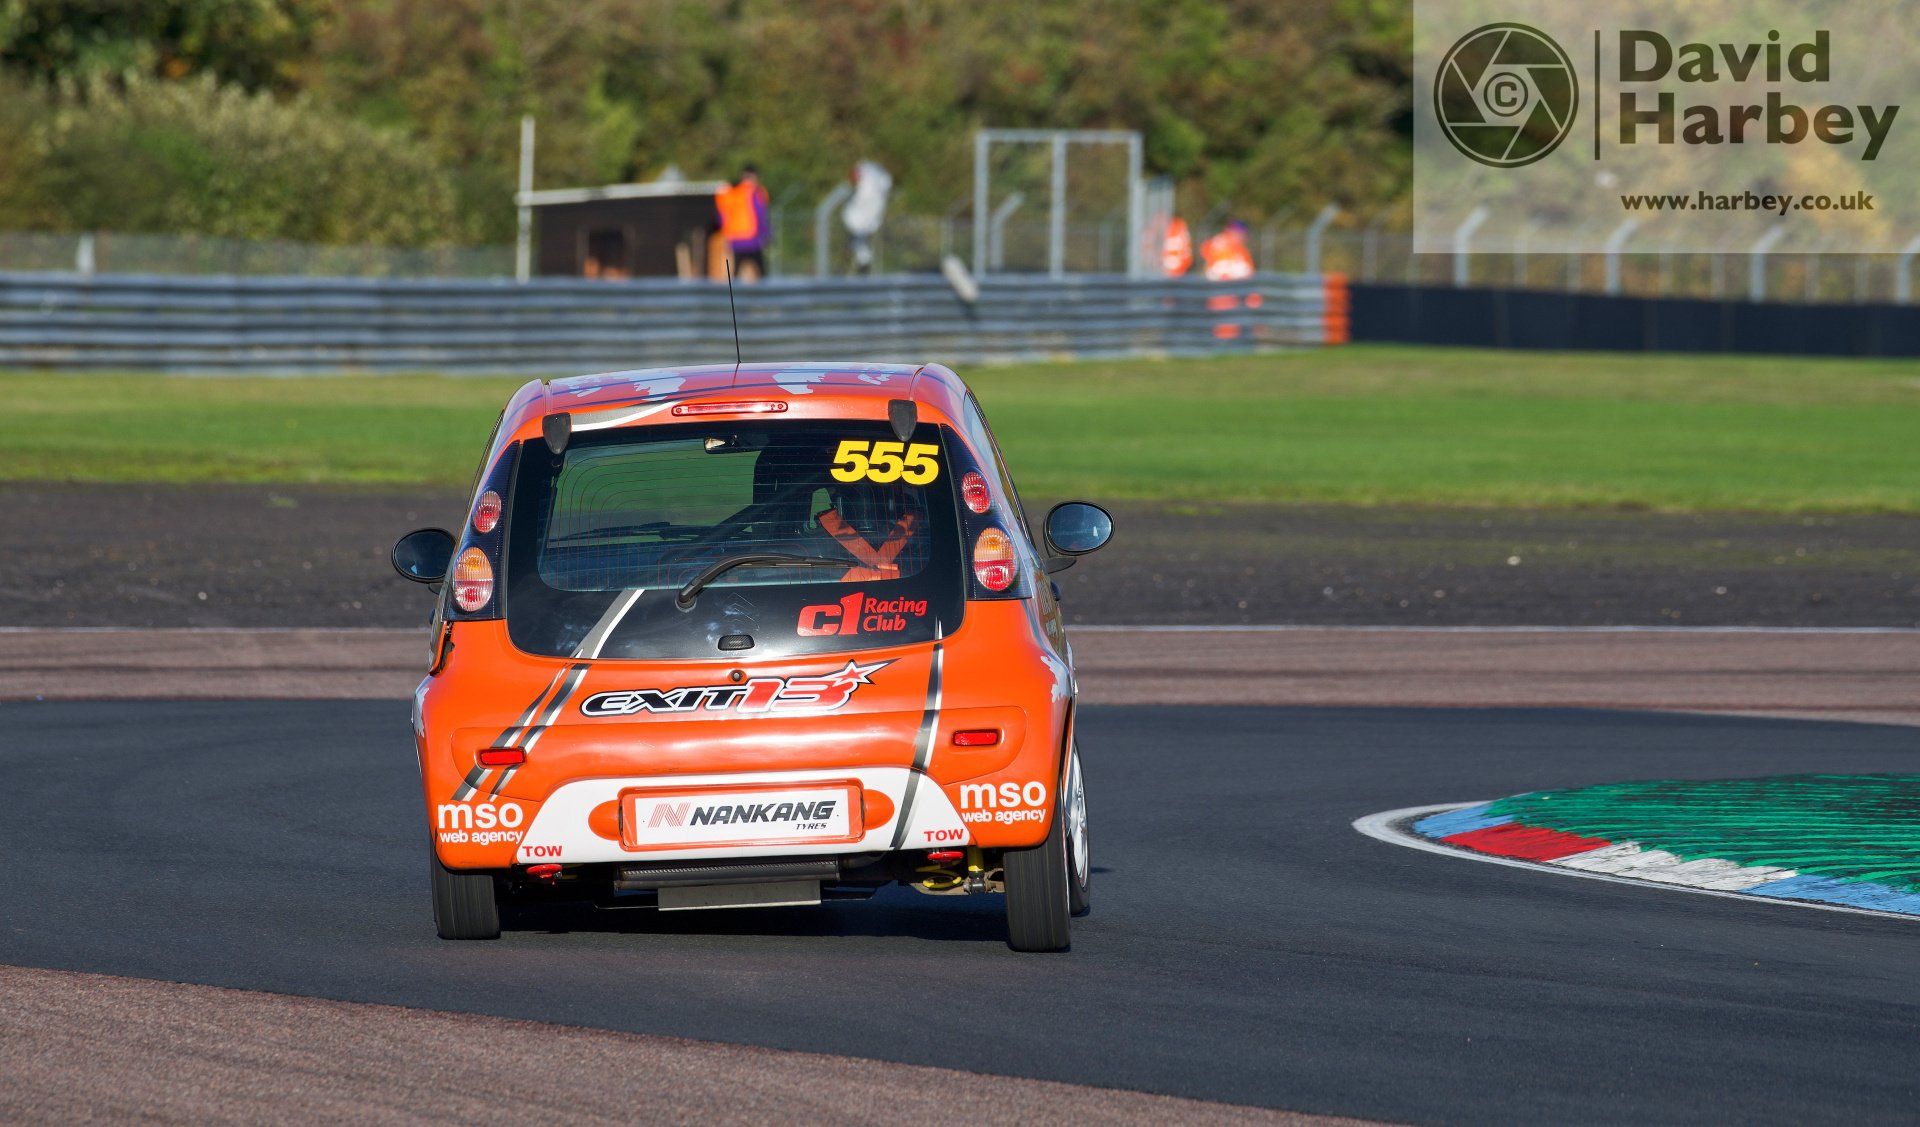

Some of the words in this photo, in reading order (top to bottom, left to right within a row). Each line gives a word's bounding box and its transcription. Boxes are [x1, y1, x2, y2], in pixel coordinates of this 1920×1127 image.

[830, 440, 939, 485] 555
[864, 596, 927, 616] Racing
[863, 615, 906, 632] Club
[960, 781, 1047, 809] mso
[437, 802, 523, 829] mso
[690, 800, 837, 826] NANKANG
[961, 809, 992, 823] web
[995, 809, 1046, 825] agency
[796, 822, 827, 830] TYRES
[440, 829, 468, 843] web
[472, 830, 523, 846] agency
[923, 829, 964, 842] TOW
[522, 846, 562, 857] TOW
